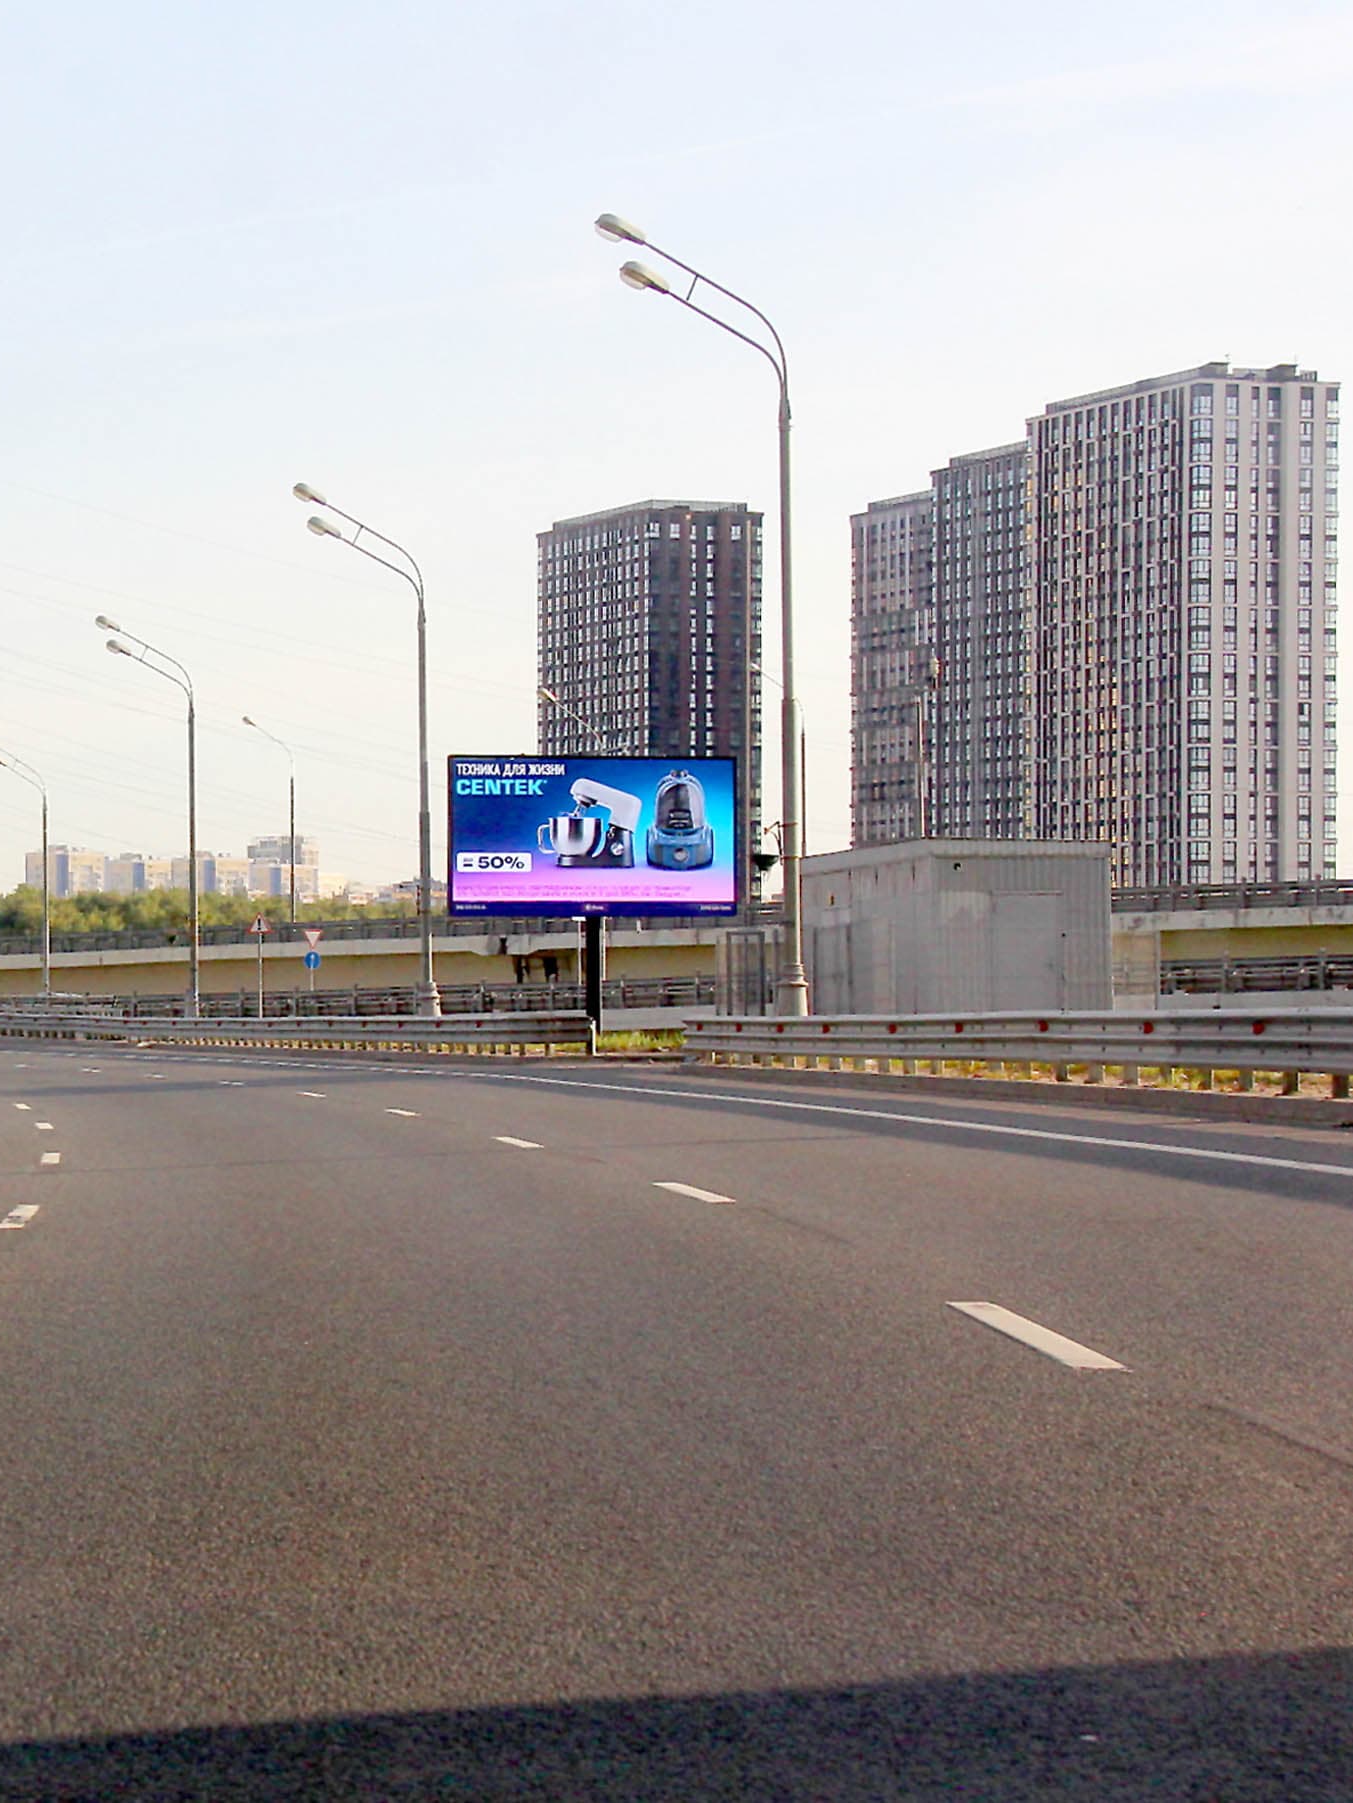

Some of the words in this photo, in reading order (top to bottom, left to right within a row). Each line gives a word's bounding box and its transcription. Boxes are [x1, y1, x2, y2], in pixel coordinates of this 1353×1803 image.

[456, 763, 501, 776] ТЕХНИКА
[502, 763, 527, 777] ДЛЯ
[528, 763, 566, 776] ЖИЗНИ
[456, 779, 544, 796] CENTEK
